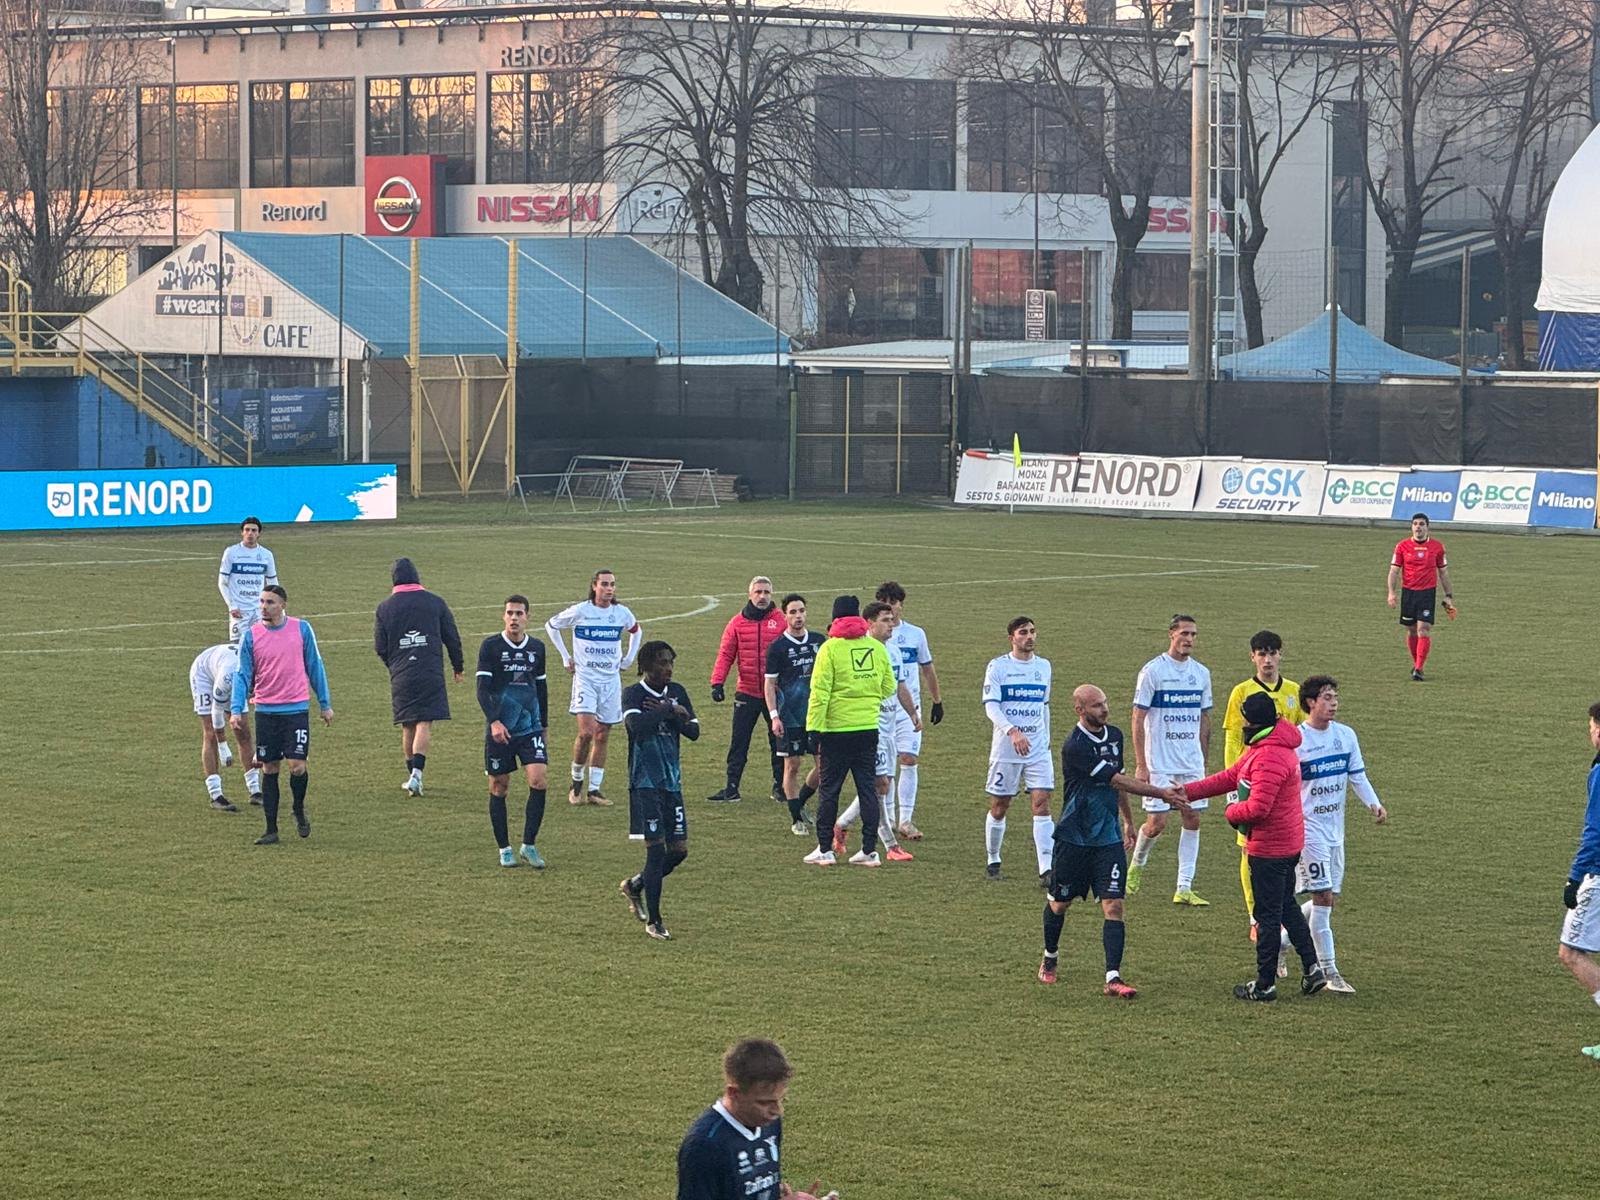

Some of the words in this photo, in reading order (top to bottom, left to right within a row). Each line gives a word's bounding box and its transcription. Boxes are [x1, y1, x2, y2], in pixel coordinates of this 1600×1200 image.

[262, 201, 327, 222] Renord
[376, 201, 414, 212] NISSAN
[477, 195, 600, 222] NISSAN
[1021, 459, 1049, 468] ILANO
[1018, 470, 1047, 479] MONZA
[1050, 459, 1182, 497] RENORD
[997, 481, 1046, 491] BARANZATE
[1245, 467, 1306, 497] GSK
[1351, 480, 1395, 497] BCC
[78, 479, 213, 517] RENORD
[966, 491, 993, 501] SESTO
[994, 493, 1002, 501] S.
[1004, 493, 1043, 502] GIOVANNI
[1401, 487, 1453, 504] Milano
[1484, 485, 1531, 502] BCC
[1538, 491, 1595, 509] Milano
[1216, 498, 1300, 512] SECURITY
[591, 629, 620, 638] gigante
[584, 647, 617, 655] CONSOLI
[1015, 687, 1046, 698] gigante
[1170, 693, 1202, 703] gigante
[200, 693, 212, 707] 13
[1163, 714, 1200, 723] CONSOLI
[295, 729, 308, 744] 15
[531, 737, 545, 749] 14
[1317, 759, 1347, 773] gigante
[994, 771, 1004, 787] 2
[675, 806, 684, 823] 5
[1110, 863, 1121, 880] 6
[1308, 861, 1326, 880] 91
